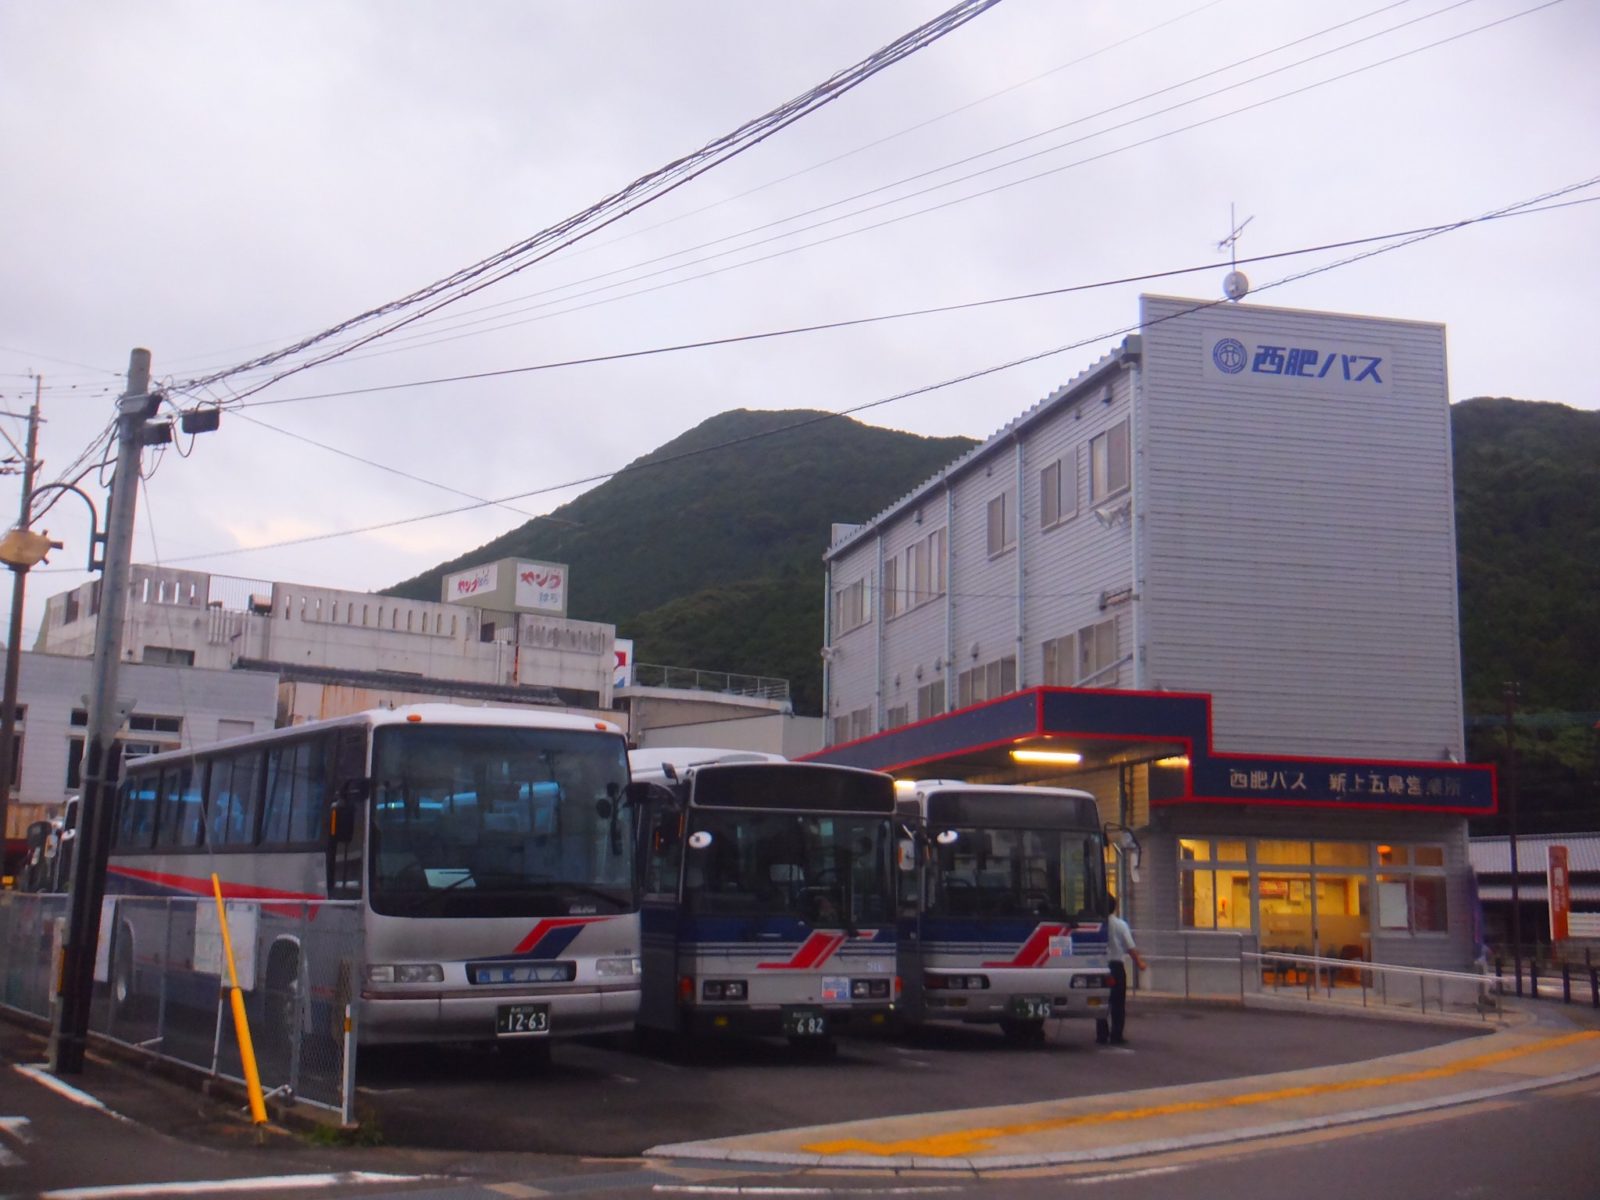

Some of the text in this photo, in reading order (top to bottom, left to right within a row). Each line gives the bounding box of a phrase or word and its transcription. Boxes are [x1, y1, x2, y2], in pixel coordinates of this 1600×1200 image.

[1252, 345, 1383, 383] 西肥バス
[1230, 770, 1307, 789] 西肥バス
